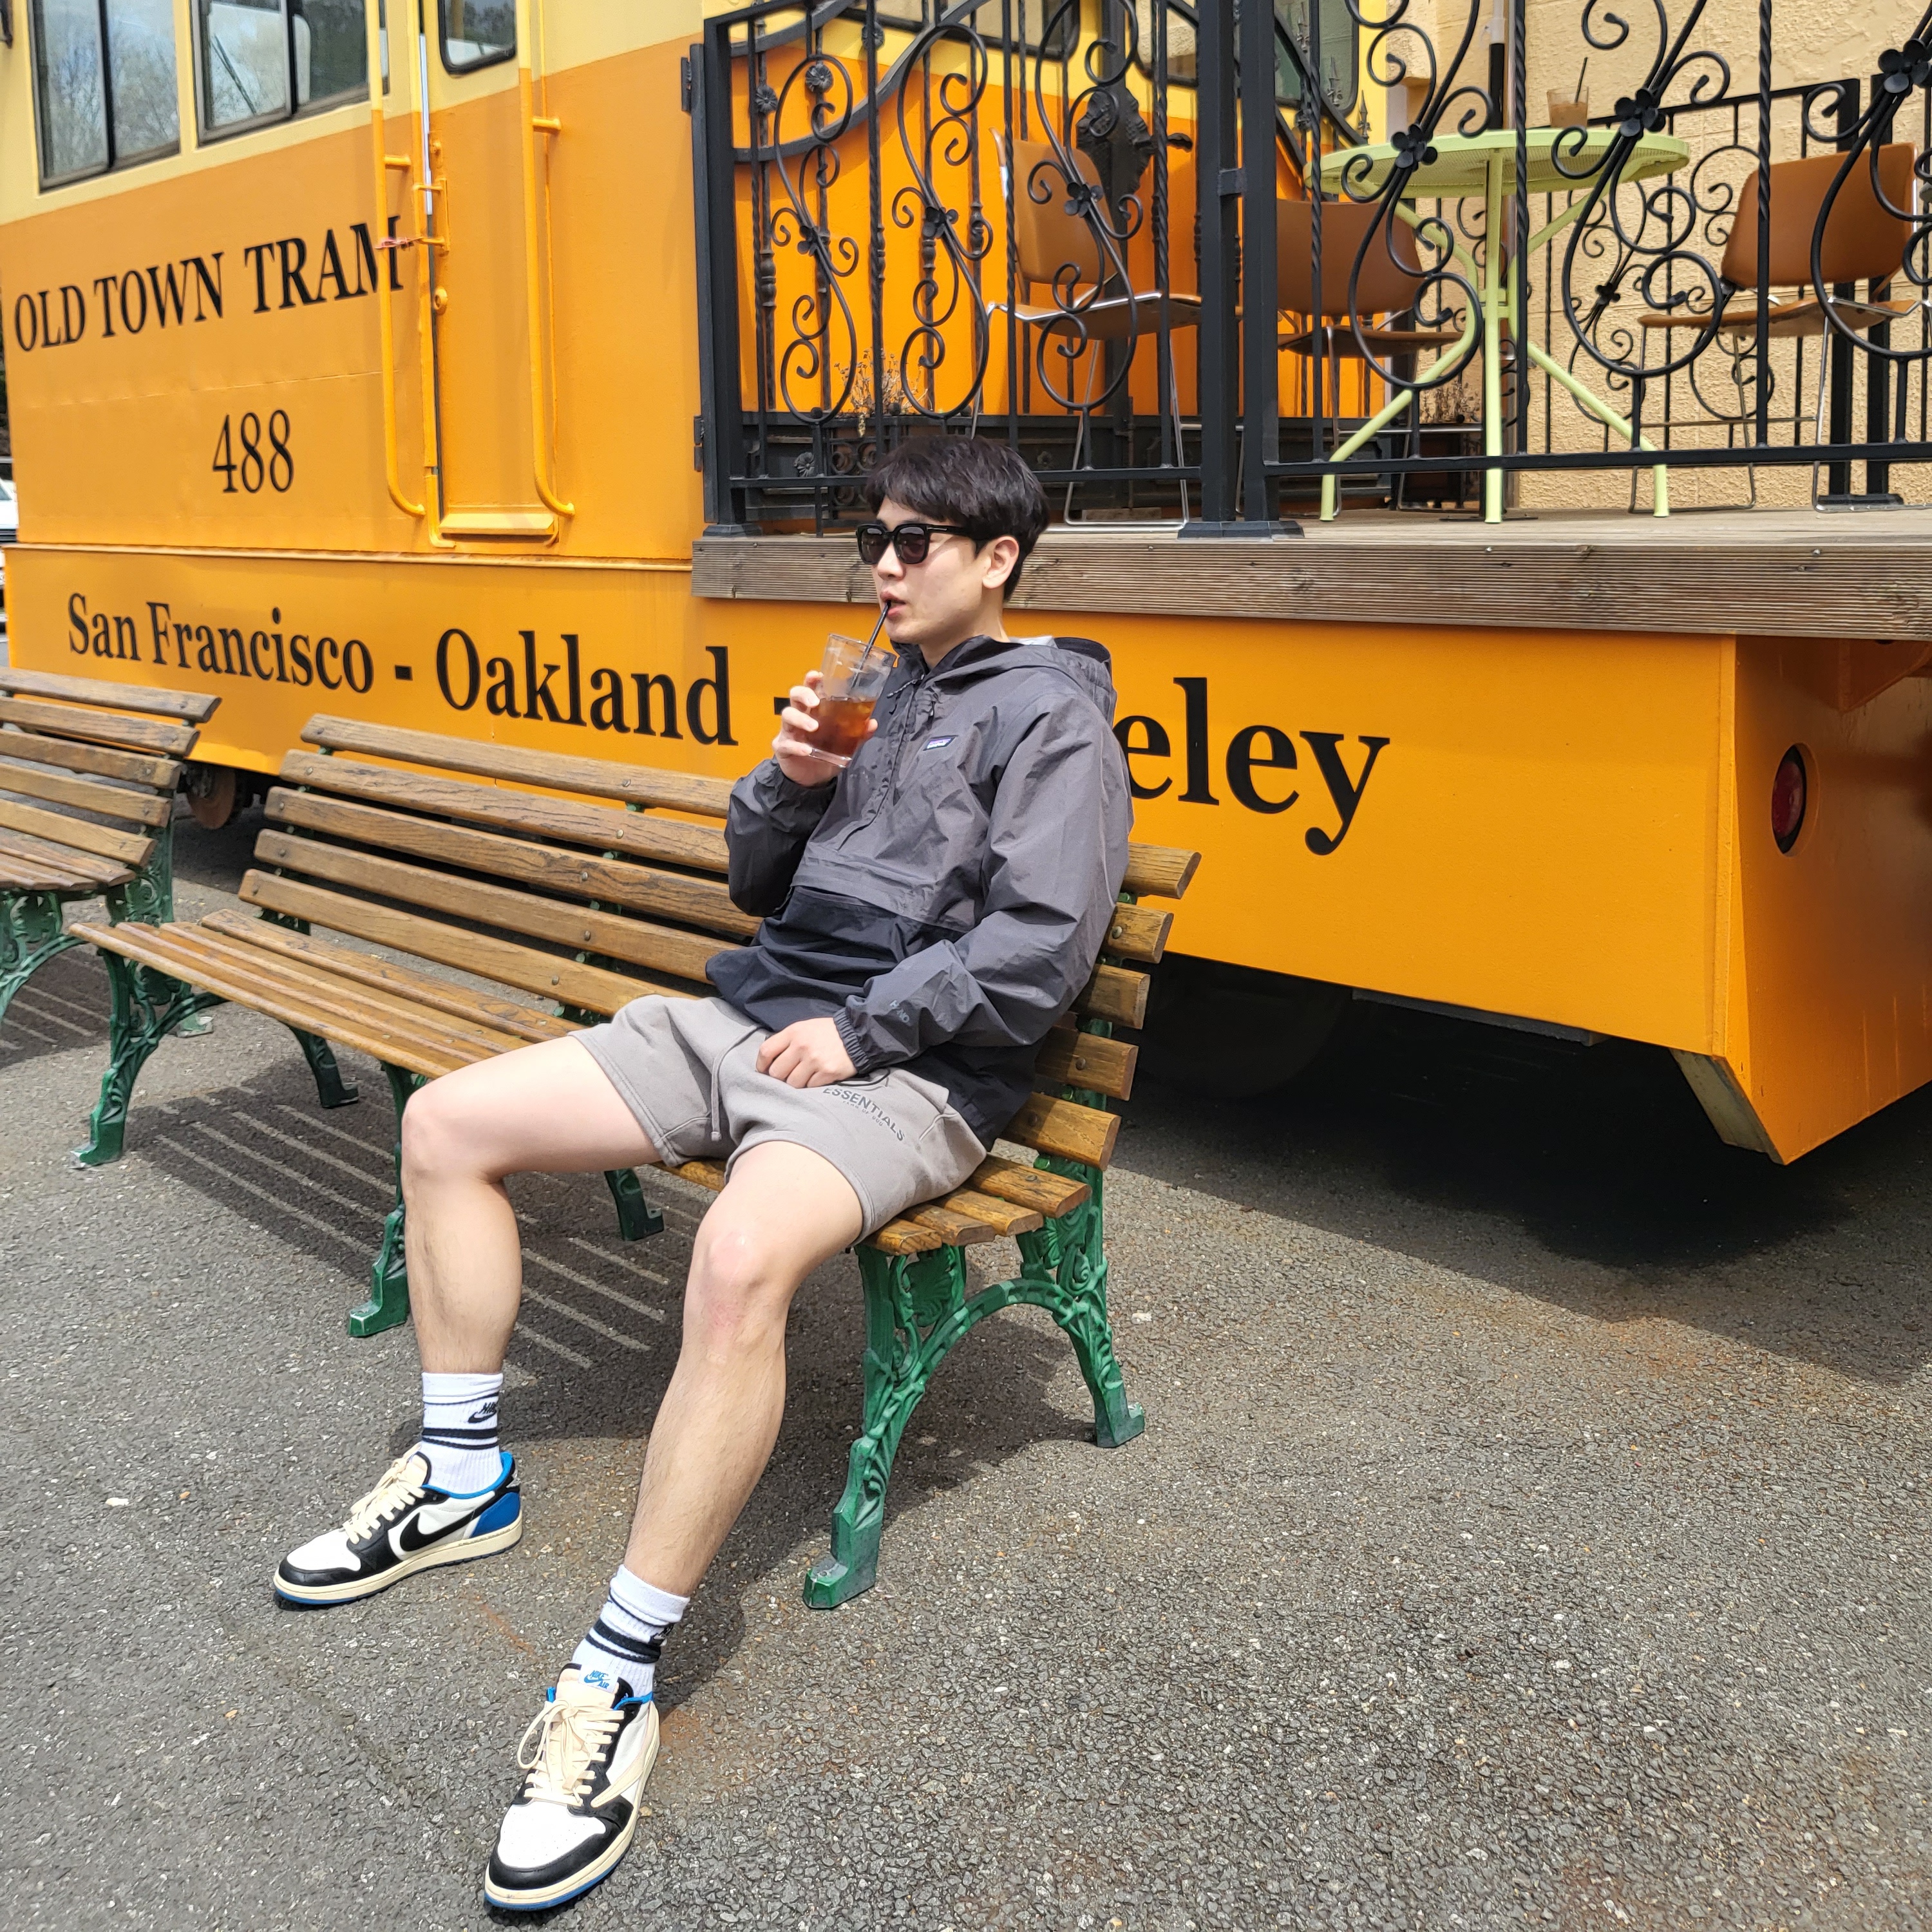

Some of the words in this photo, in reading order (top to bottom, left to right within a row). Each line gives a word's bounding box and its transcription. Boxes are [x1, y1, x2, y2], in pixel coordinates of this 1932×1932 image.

[14, 285, 86, 352] OLD
[93, 252, 224, 338] TOWN
[243, 215, 404, 314] TRAM
[212, 409, 294, 493] 488
[69, 593, 141, 661] San
[146, 601, 374, 694] Francisco
[436, 629, 738, 746] Oakland
[1113, 677, 1390, 855] eley
[823, 1088, 905, 1141] ESSENTIALS
[589, 1670, 609, 1680] NIKE
[597, 1680, 610, 1689] AIR
